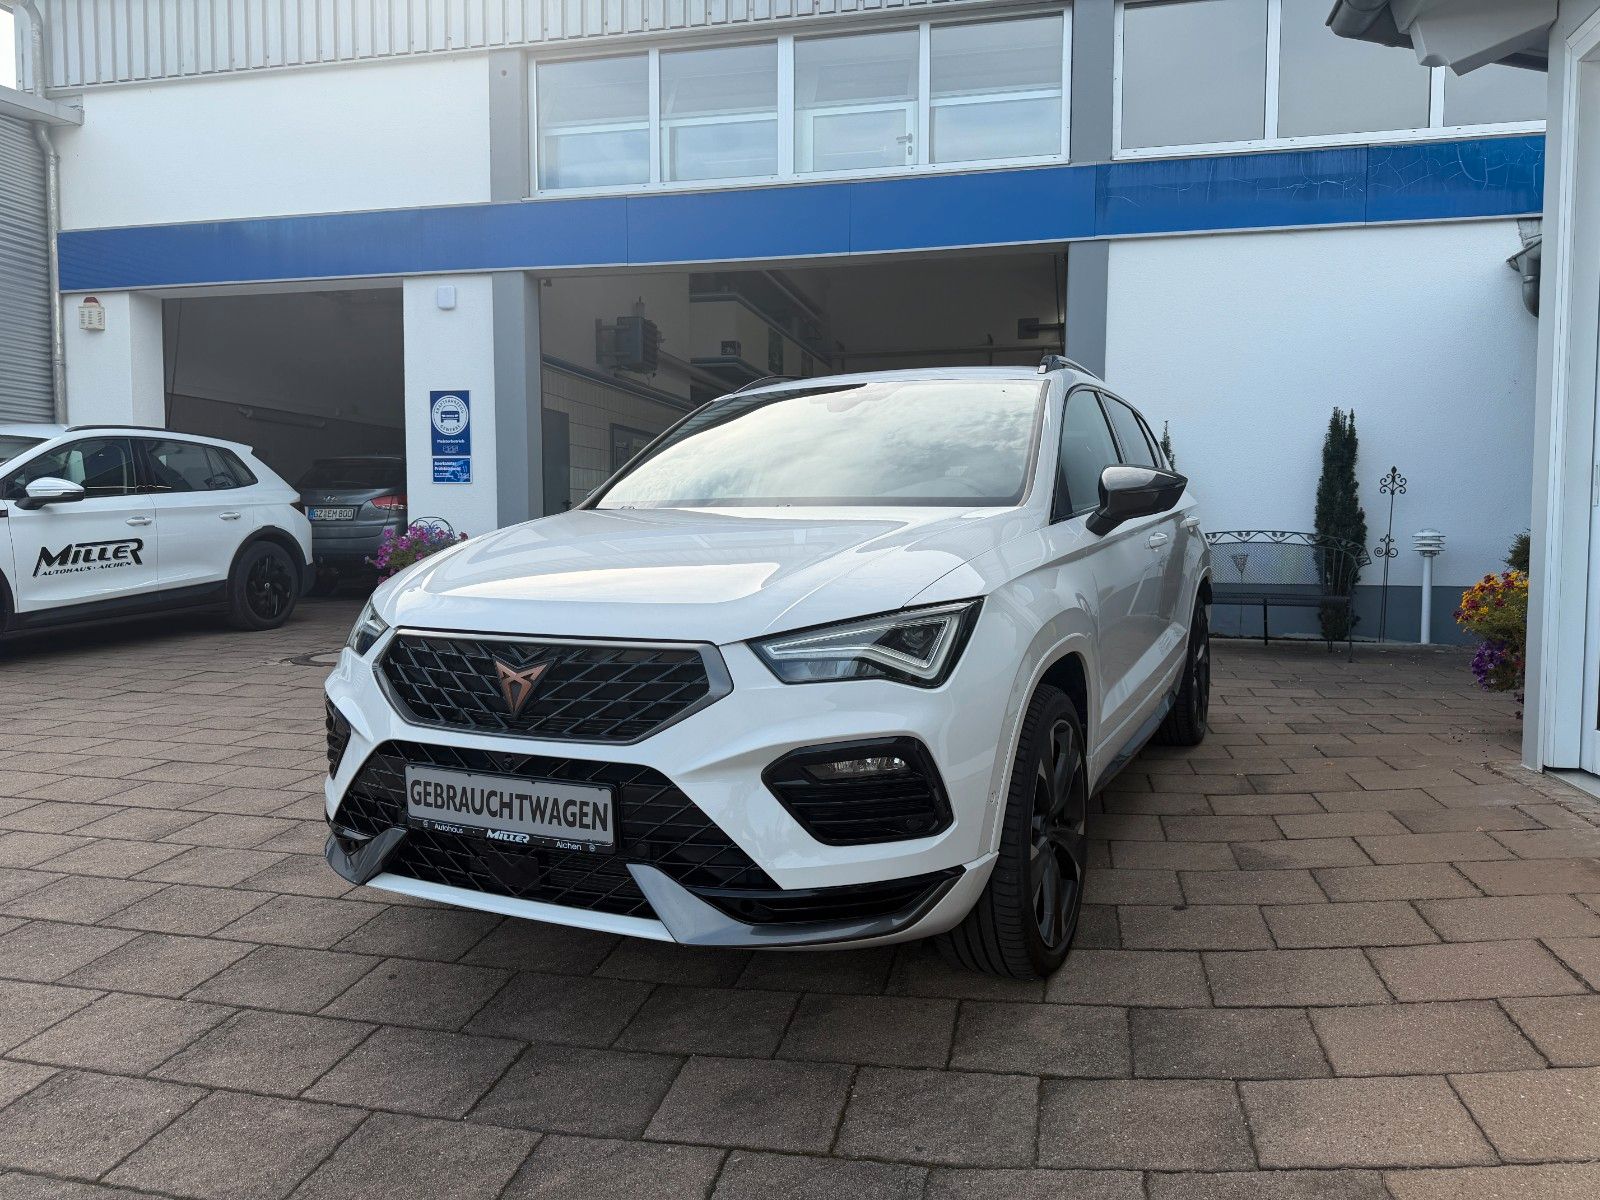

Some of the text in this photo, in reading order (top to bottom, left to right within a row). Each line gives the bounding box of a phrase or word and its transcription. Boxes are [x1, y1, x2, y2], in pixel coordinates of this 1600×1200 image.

[40, 561, 132, 576] AUTOHAUS AICHEN
[410, 779, 608, 831] GEBRAUCHTWAGEN
[434, 822, 463, 834] Autohaus
[556, 839, 582, 851] Aichen
